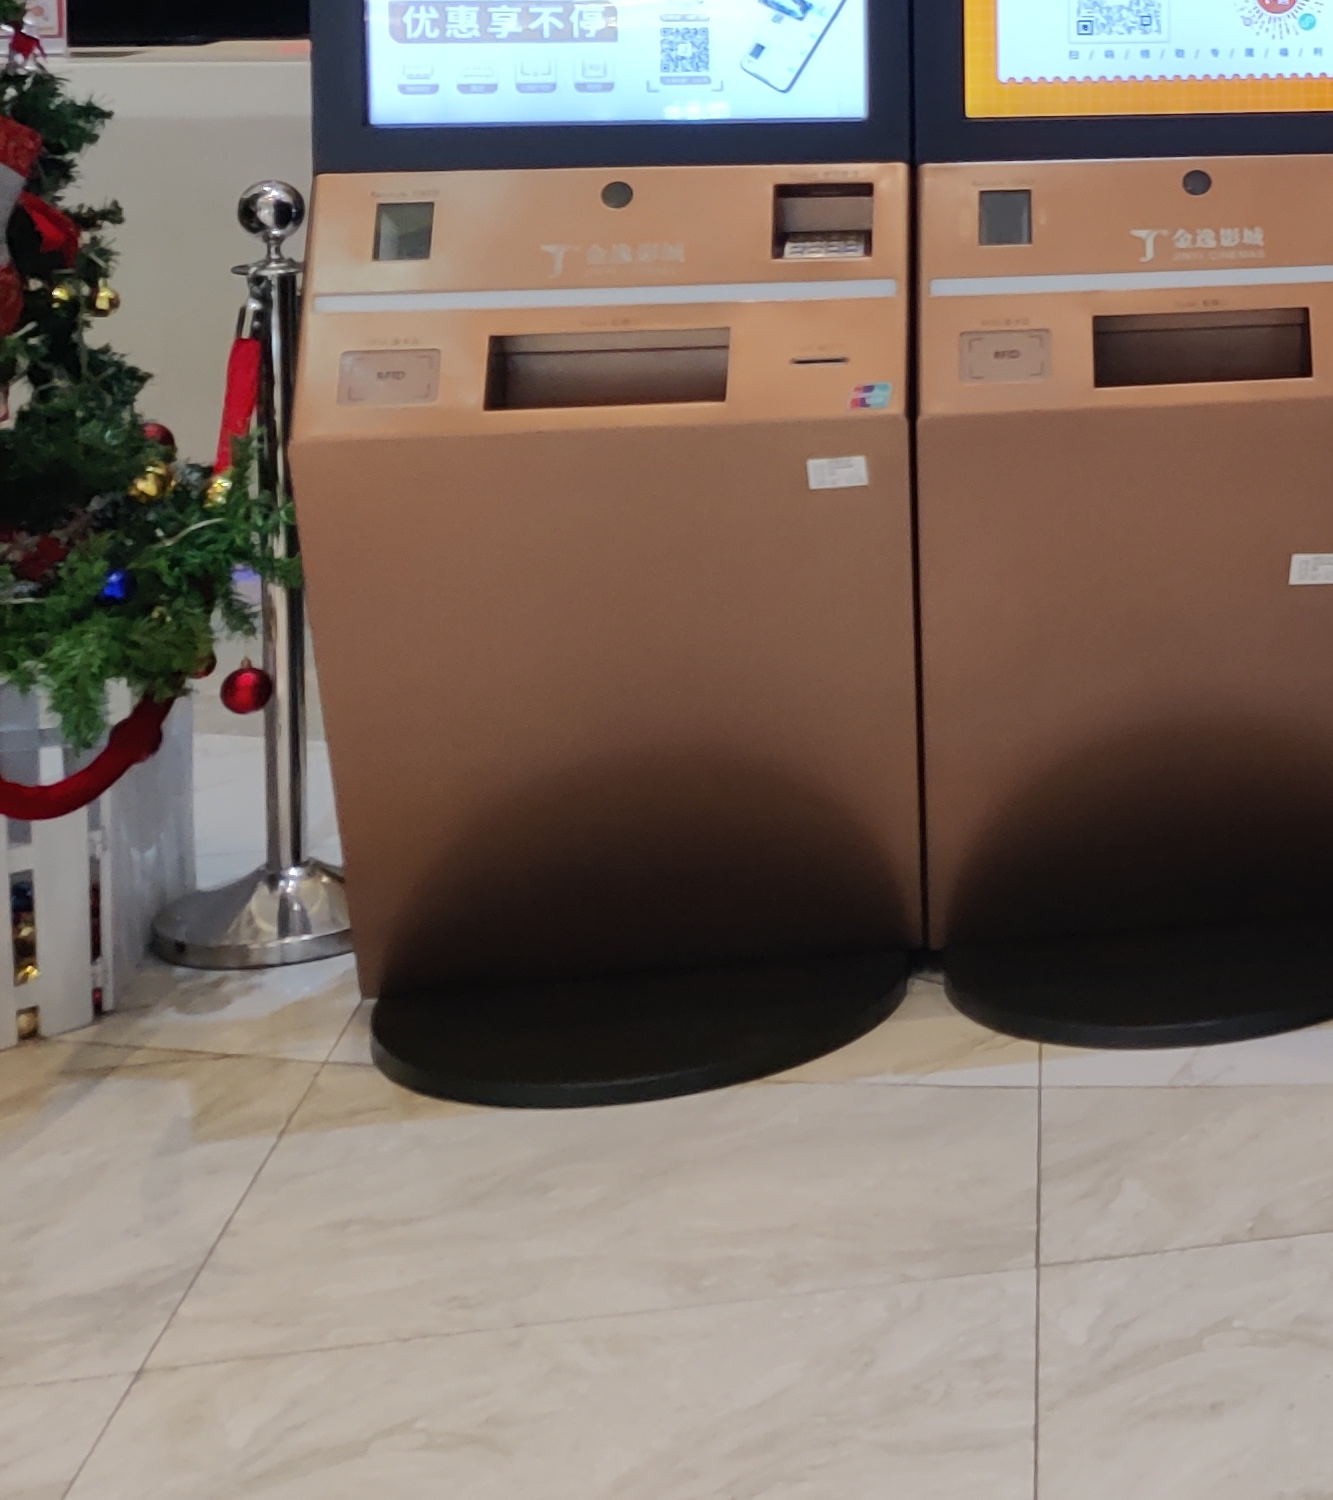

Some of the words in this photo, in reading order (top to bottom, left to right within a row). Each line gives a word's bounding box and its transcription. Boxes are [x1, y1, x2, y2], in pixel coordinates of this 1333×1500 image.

[402, 5, 606, 39] 优惠享不停
[1172, 227, 1265, 248] 金逸影城
